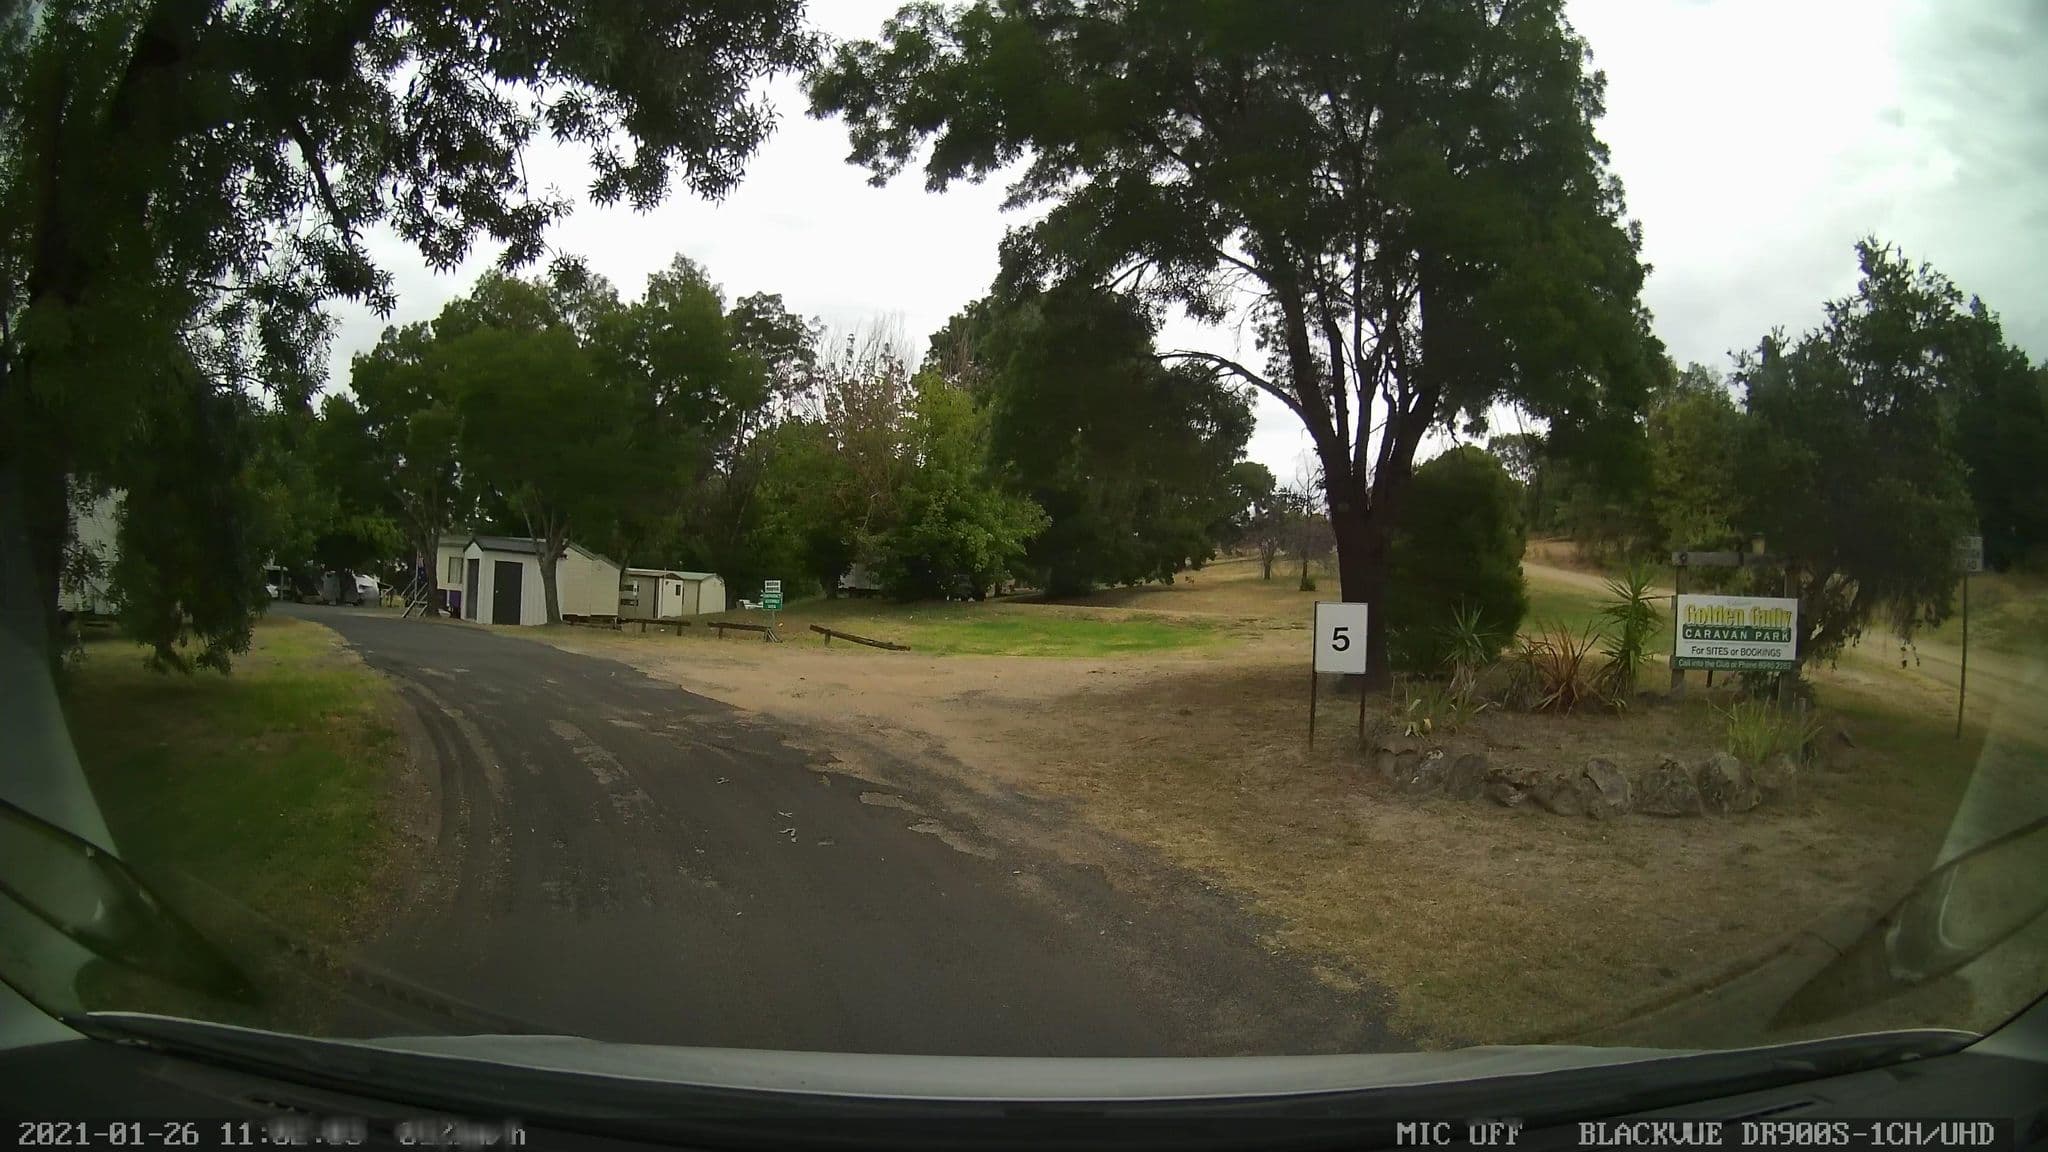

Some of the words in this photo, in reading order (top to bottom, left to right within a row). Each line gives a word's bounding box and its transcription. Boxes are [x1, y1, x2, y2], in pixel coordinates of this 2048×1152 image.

[1685, 604, 1745, 628] Golden
[1751, 606, 1793, 630] Gully
[1332, 627, 1350, 652] 5
[1685, 629, 1748, 640] CARAVAN
[1755, 631, 1790, 642] PARK
[1691, 646, 1704, 655] For
[1706, 646, 1729, 656] SITES
[1740, 647, 1782, 657] BOOKINGS
